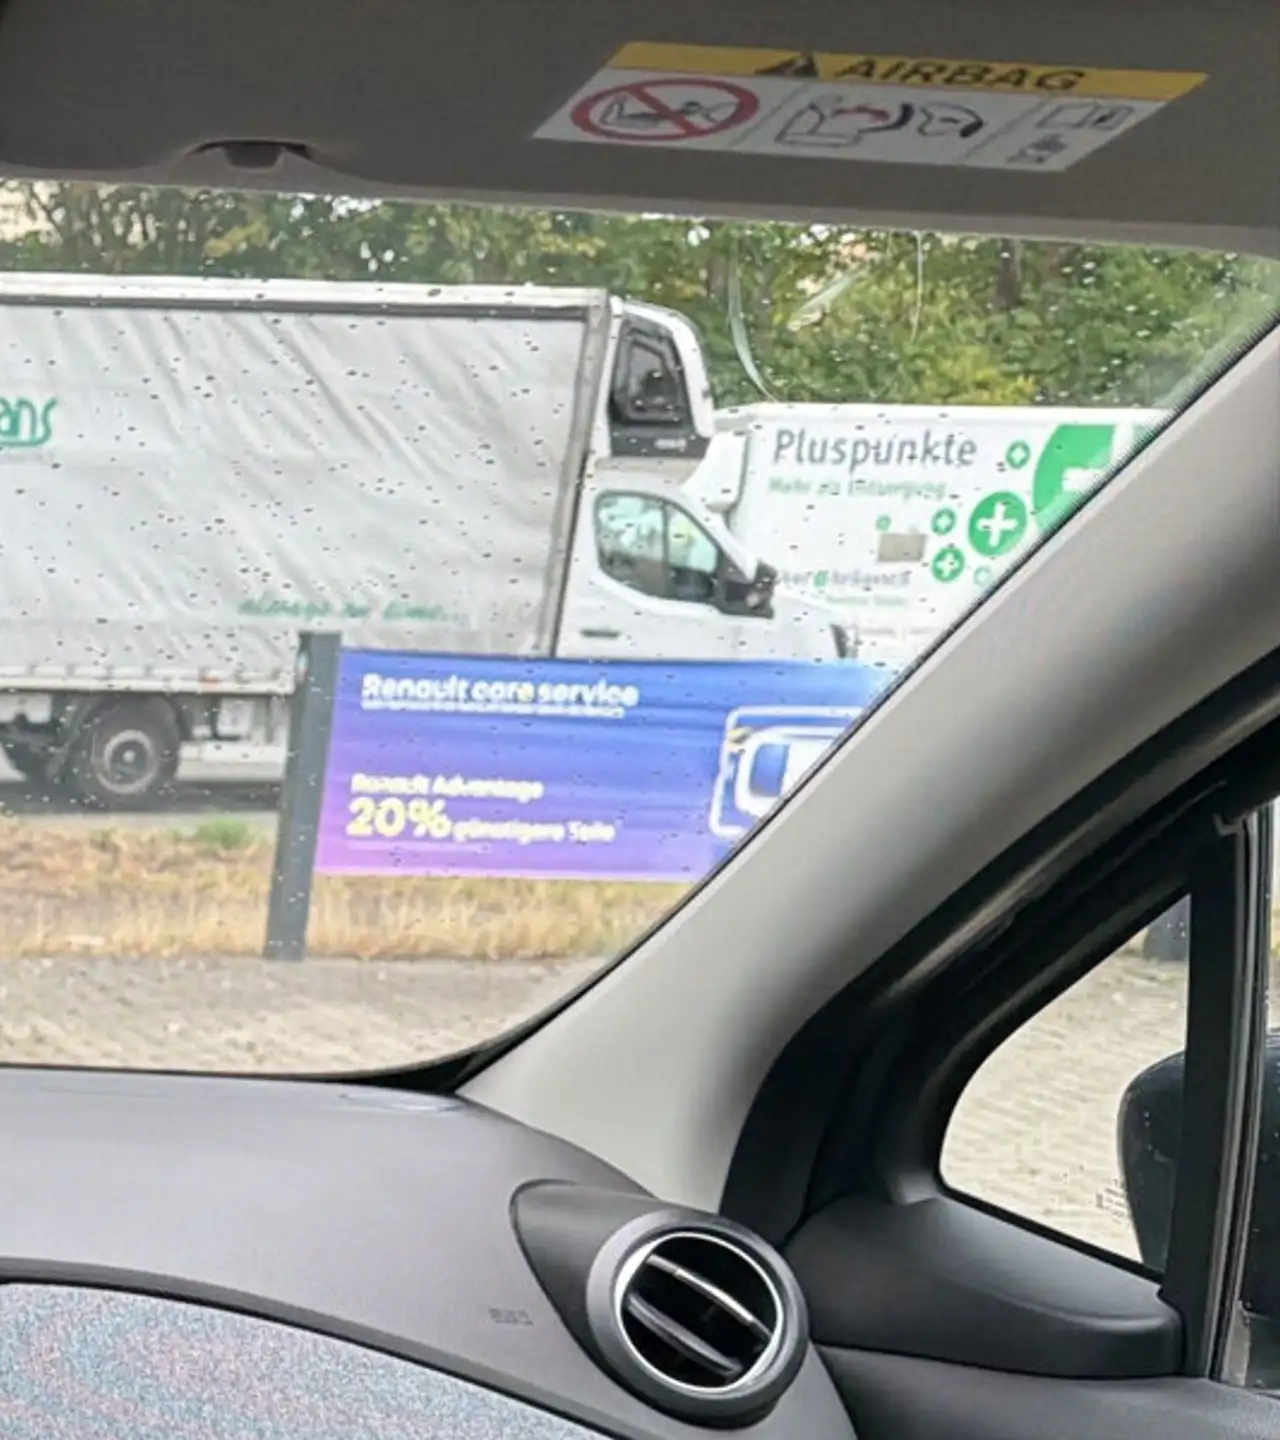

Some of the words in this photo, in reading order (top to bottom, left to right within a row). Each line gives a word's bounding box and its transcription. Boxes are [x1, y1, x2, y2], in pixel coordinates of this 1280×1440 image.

[834, 56, 1085, 91] AIRBAG
[773, 428, 977, 474] Pluspunkte
[362, 673, 469, 701] Renault
[471, 678, 533, 702] care
[538, 679, 638, 706] service
[346, 797, 451, 838] 20%
